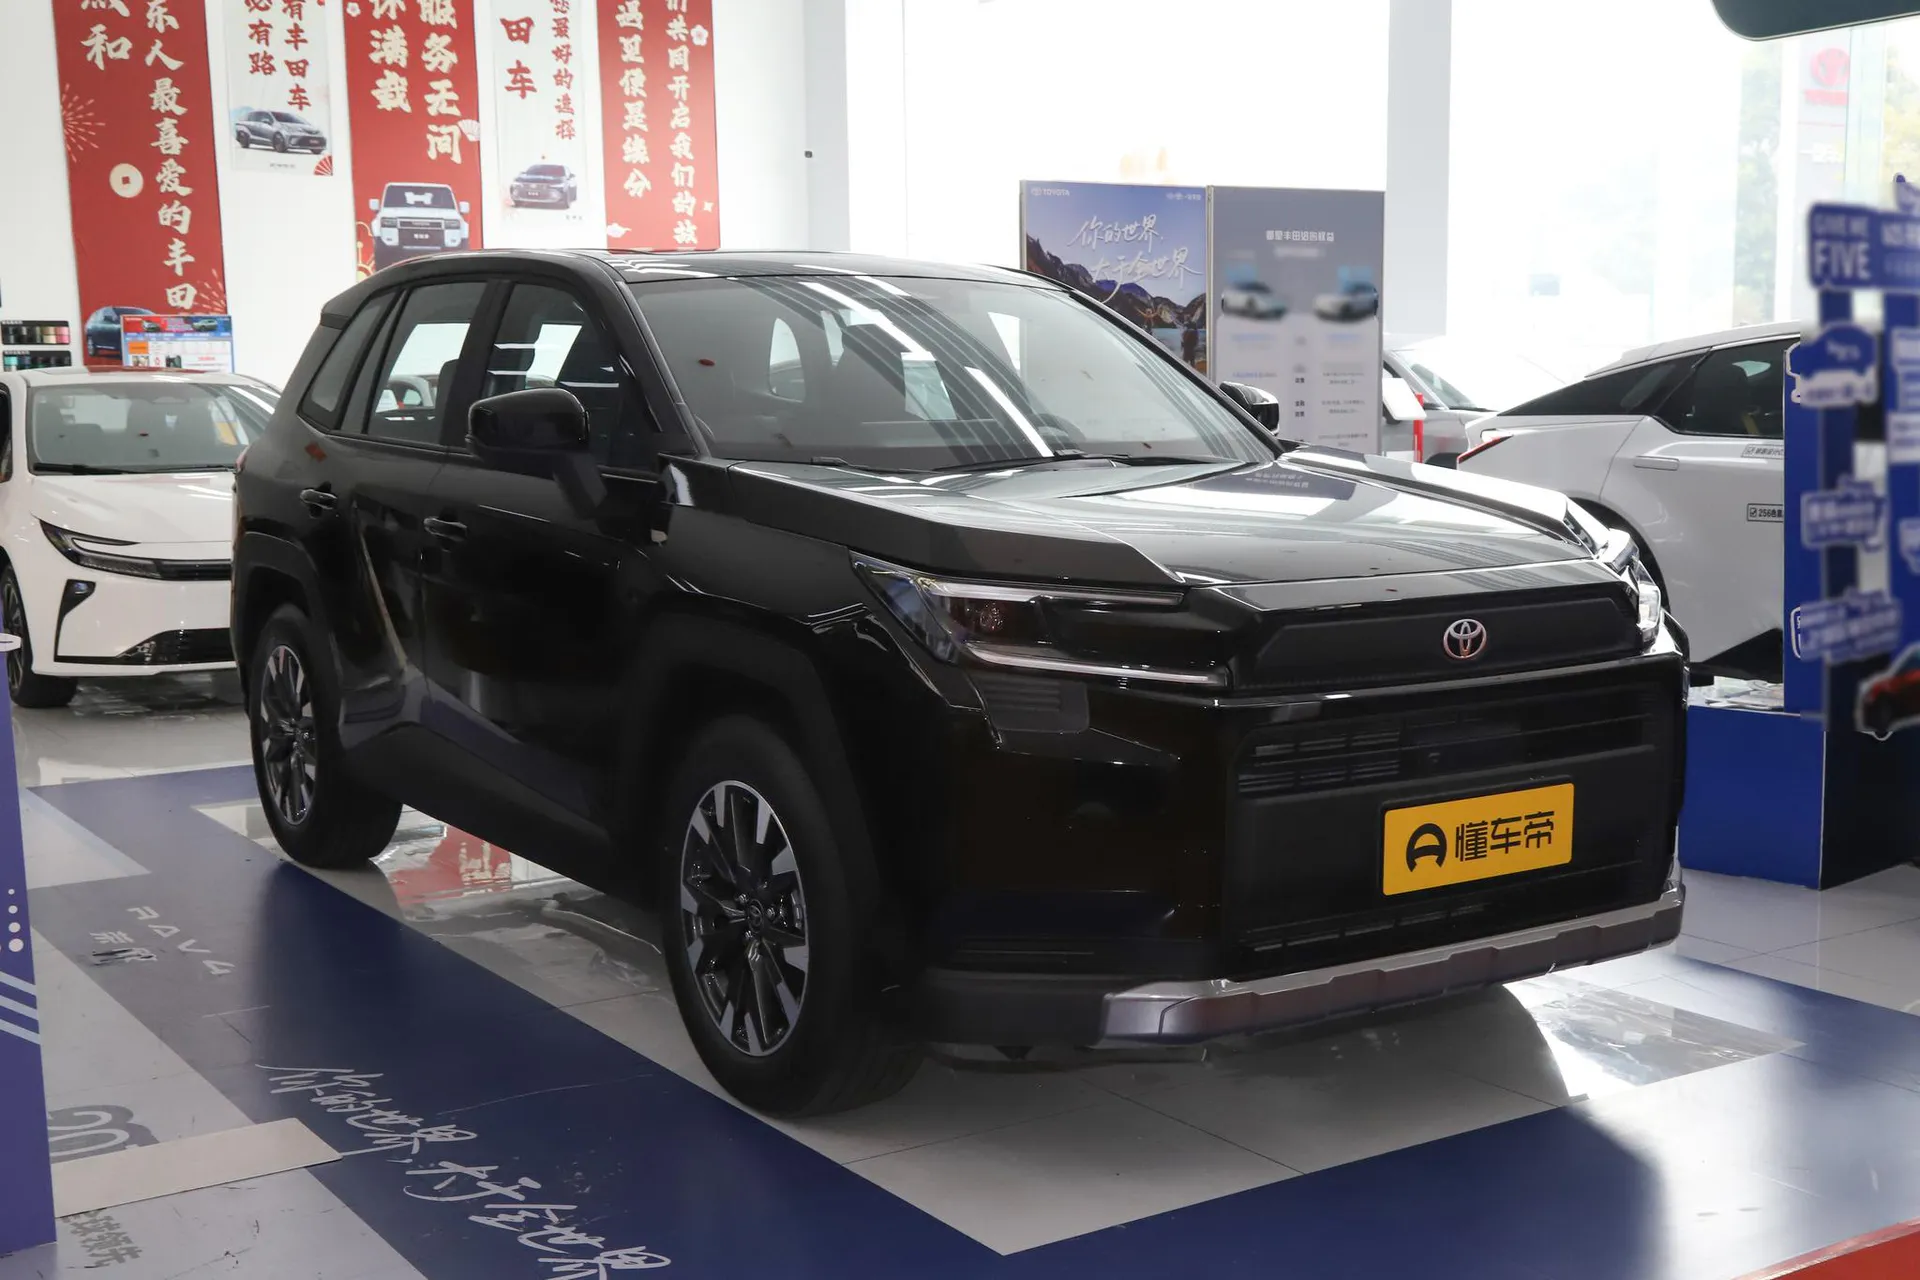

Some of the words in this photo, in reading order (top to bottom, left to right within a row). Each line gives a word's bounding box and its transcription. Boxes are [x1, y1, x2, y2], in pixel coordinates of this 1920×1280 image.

[281, 0, 312, 111] 有丰田车
[416, 0, 462, 165] 服务无间
[499, 16, 538, 100] 田车
[1043, 187, 1071, 197] TOYOTA
[1090, 246, 1204, 304] 大于全世界
[1813, 240, 1871, 281] FIVE
[1455, 810, 1555, 862] 懂车帝
[126, 896, 236, 976] RAV4
